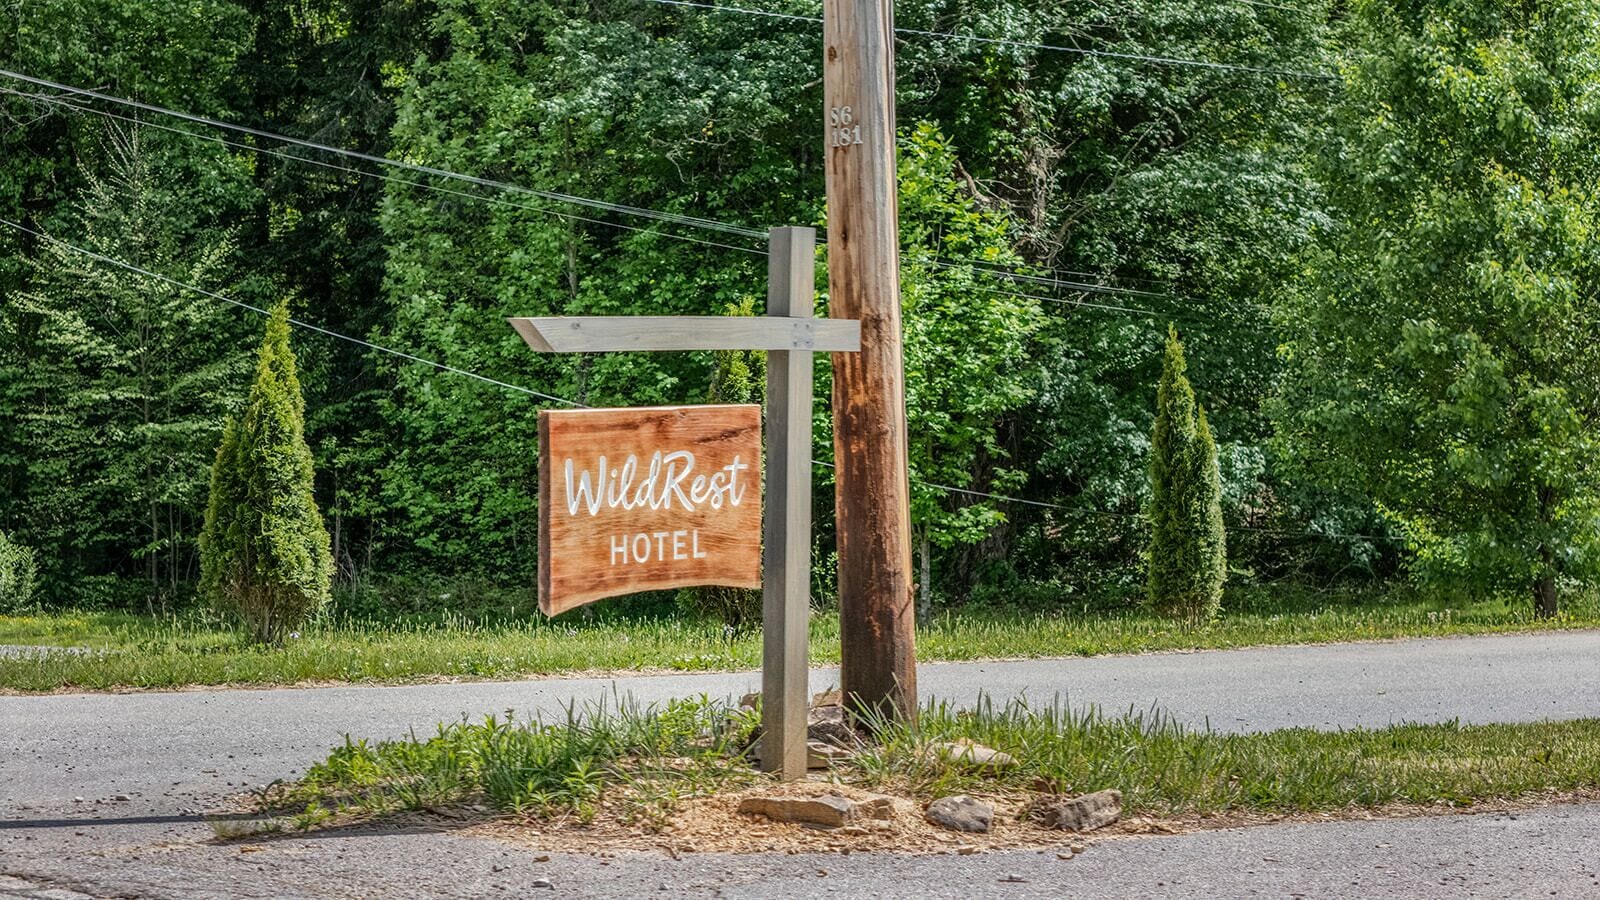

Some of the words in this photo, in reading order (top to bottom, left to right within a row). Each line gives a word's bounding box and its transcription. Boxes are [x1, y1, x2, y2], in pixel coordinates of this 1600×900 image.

[831, 124, 864, 148] 181
[565, 450, 748, 516] WildRest
[610, 529, 706, 565] HOTEL
